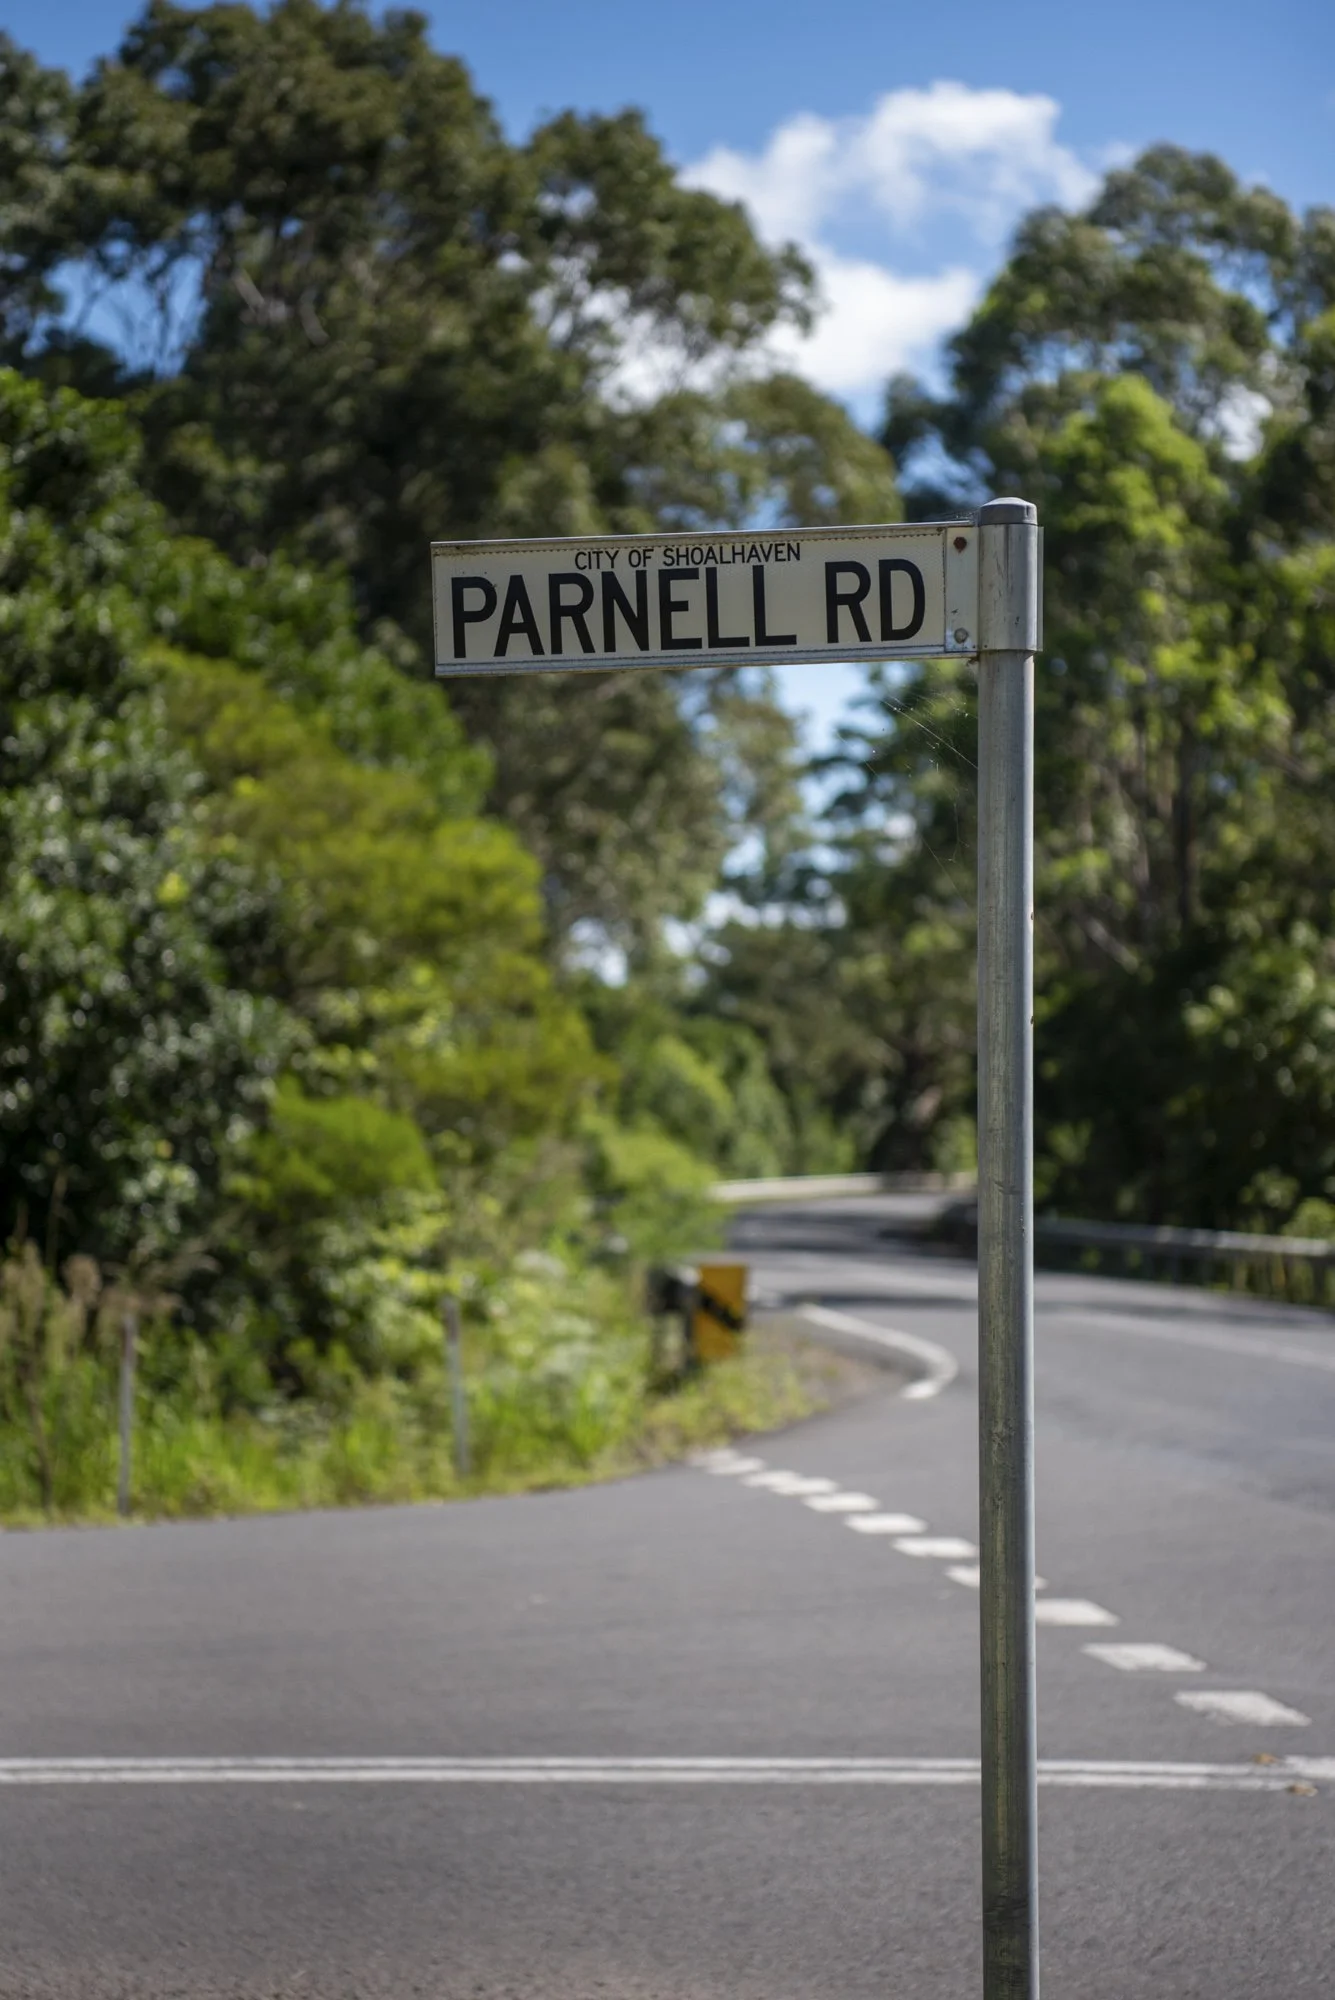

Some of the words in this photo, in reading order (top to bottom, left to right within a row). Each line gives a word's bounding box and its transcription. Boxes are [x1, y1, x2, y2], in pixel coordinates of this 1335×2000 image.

[575, 549, 620, 570] CITY
[628, 548, 654, 568] OF
[662, 543, 801, 567] SHOALHAVEN
[451, 564, 798, 659] PARNELL
[825, 558, 926, 644] RD
